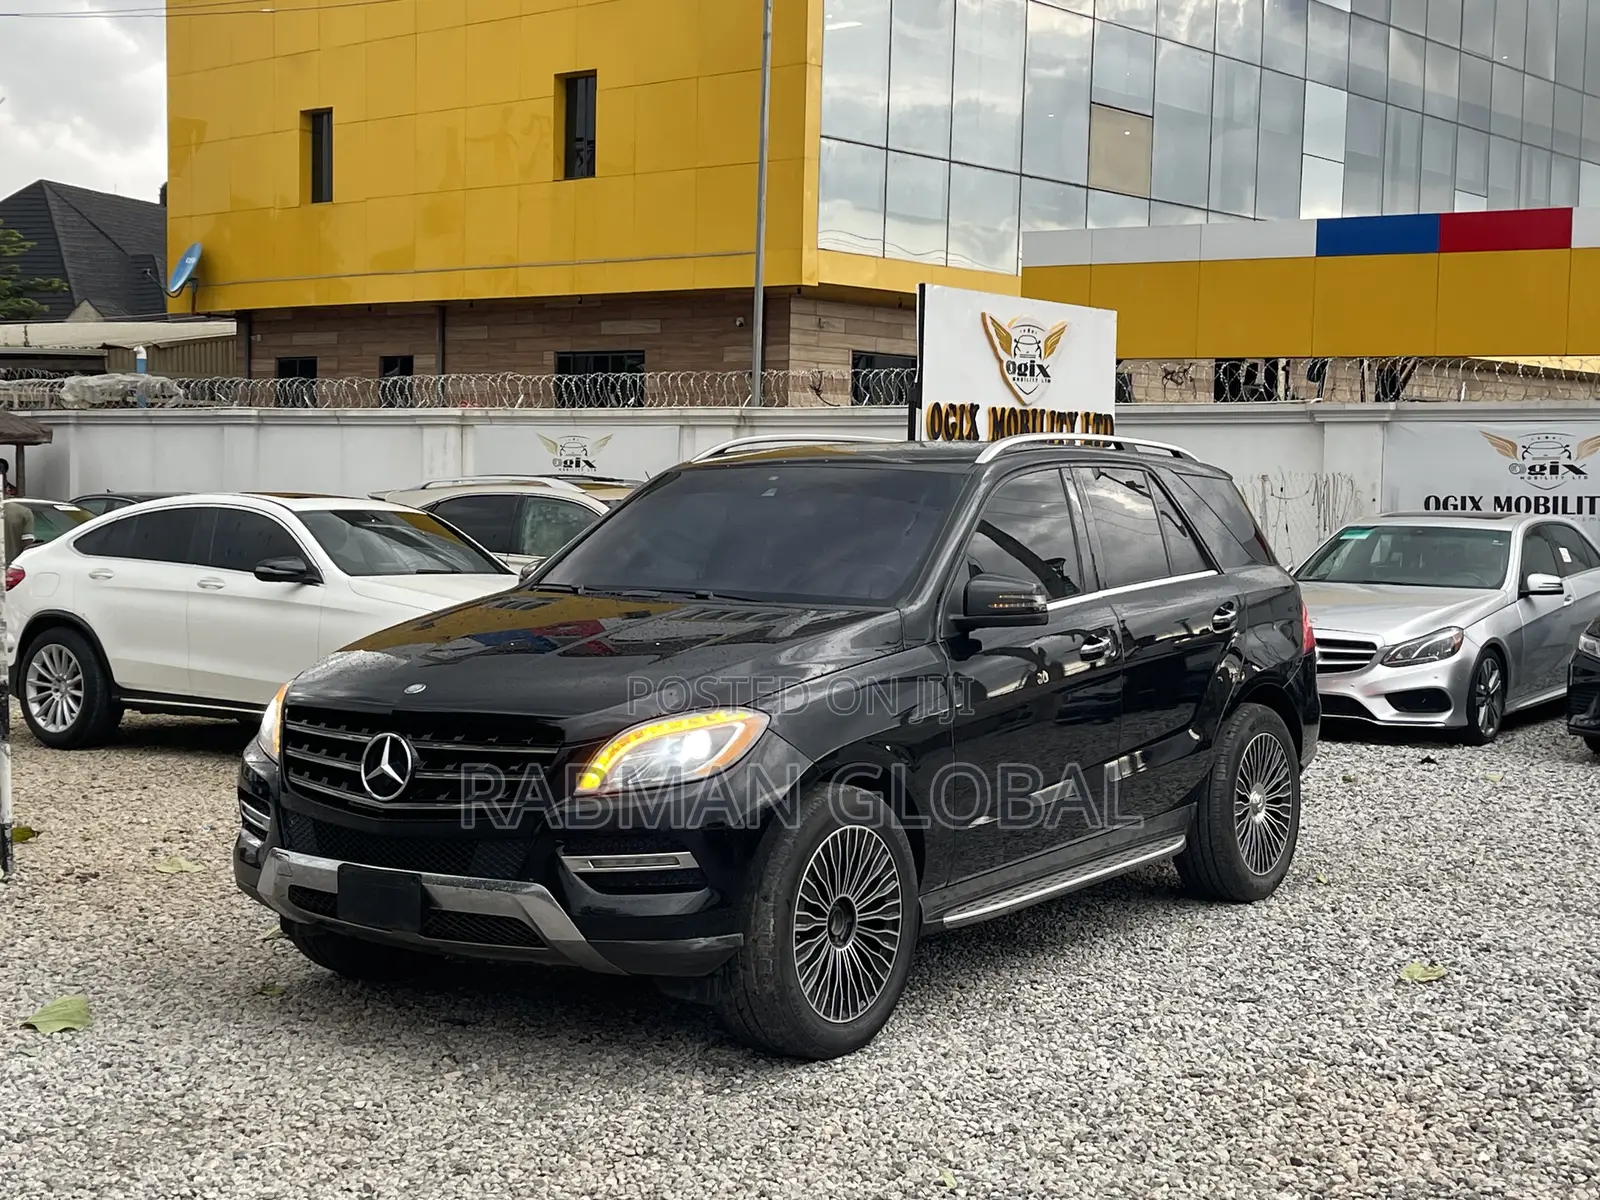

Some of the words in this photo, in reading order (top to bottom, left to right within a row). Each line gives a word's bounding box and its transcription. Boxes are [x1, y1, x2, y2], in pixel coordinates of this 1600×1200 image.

[927, 402, 980, 441] OGIX
[988, 406, 1079, 444] MOBILITY
[1080, 411, 1115, 447] LTD
[1424, 495, 1483, 512] OGIX
[1493, 495, 1600, 515] MOBILIT
